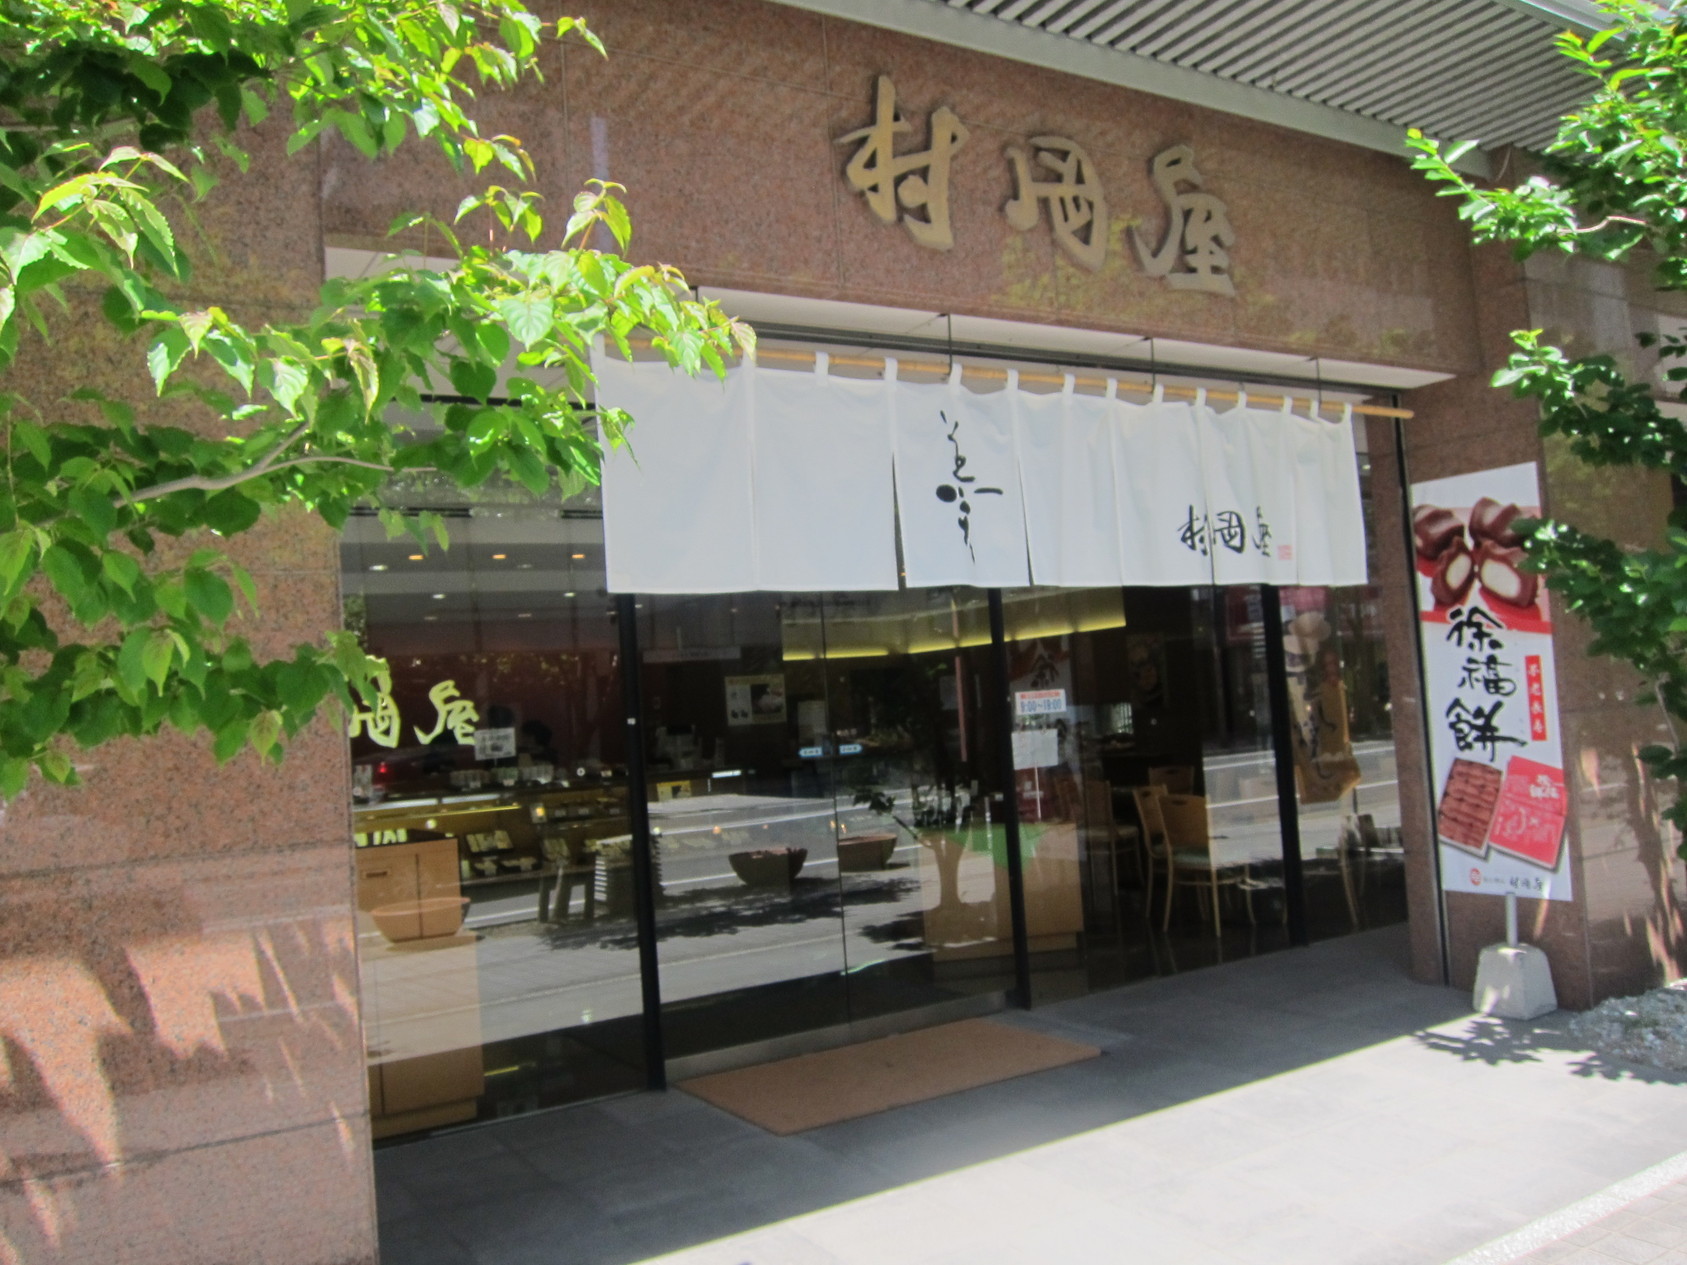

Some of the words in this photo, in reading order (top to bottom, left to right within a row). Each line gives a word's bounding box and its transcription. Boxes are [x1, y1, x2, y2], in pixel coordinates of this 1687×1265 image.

[833, 75, 1236, 298] 村岡屋
[1177, 504, 1272, 557] 村岡屋
